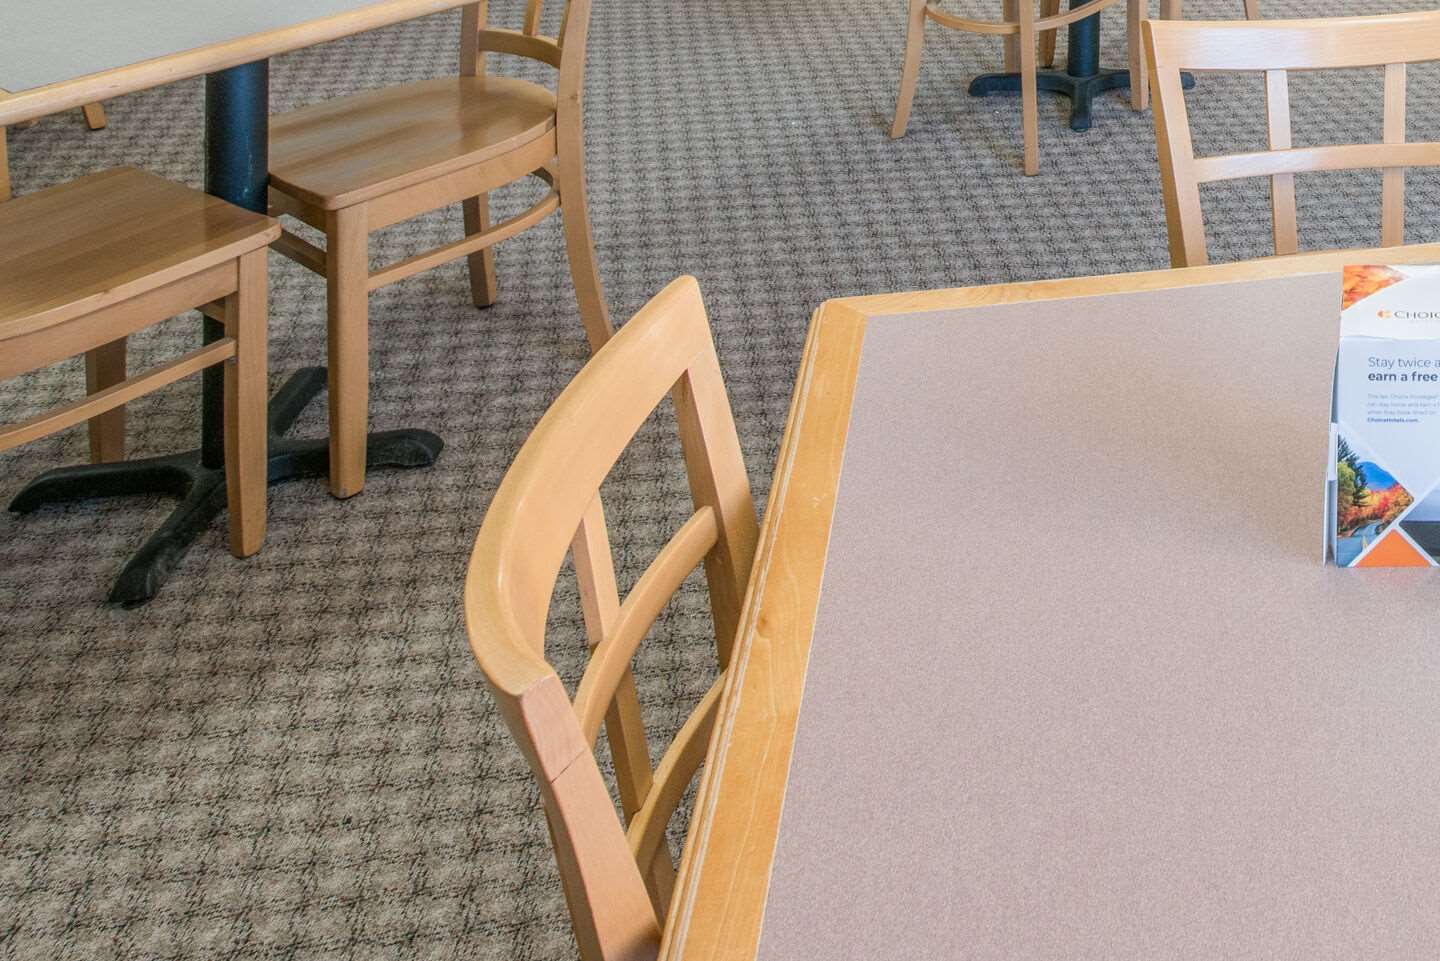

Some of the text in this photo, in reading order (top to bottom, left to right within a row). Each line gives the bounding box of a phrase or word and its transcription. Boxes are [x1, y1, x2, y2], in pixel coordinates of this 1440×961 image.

[1368, 357, 1395, 369] Stay
[1398, 357, 1431, 367] twice
[1368, 372, 1396, 382] earn
[1400, 373, 1408, 381] a
[1411, 371, 1438, 382] free
